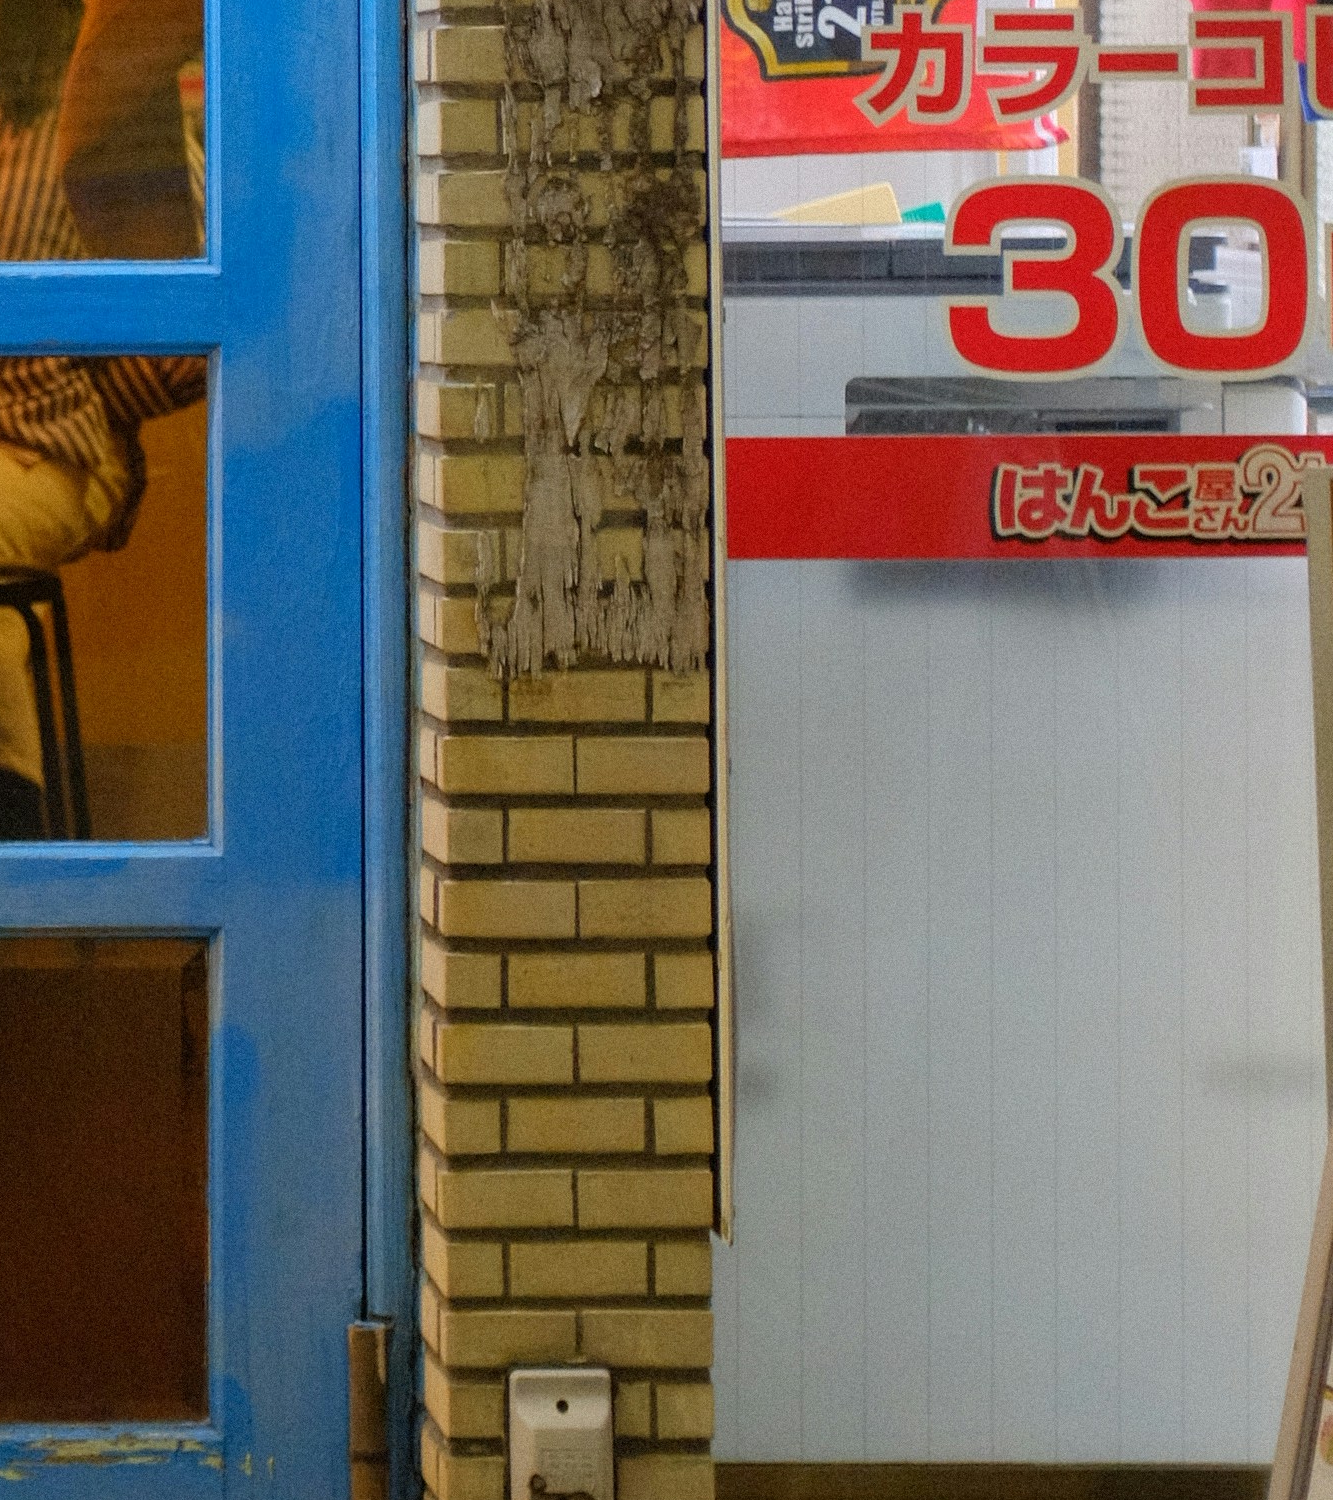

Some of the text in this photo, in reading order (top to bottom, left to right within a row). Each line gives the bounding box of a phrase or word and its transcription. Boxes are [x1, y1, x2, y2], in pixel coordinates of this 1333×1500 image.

[856, 6, 1333, 124] カラーコ
[994, 443, 1325, 539] はんこ屋さん2
